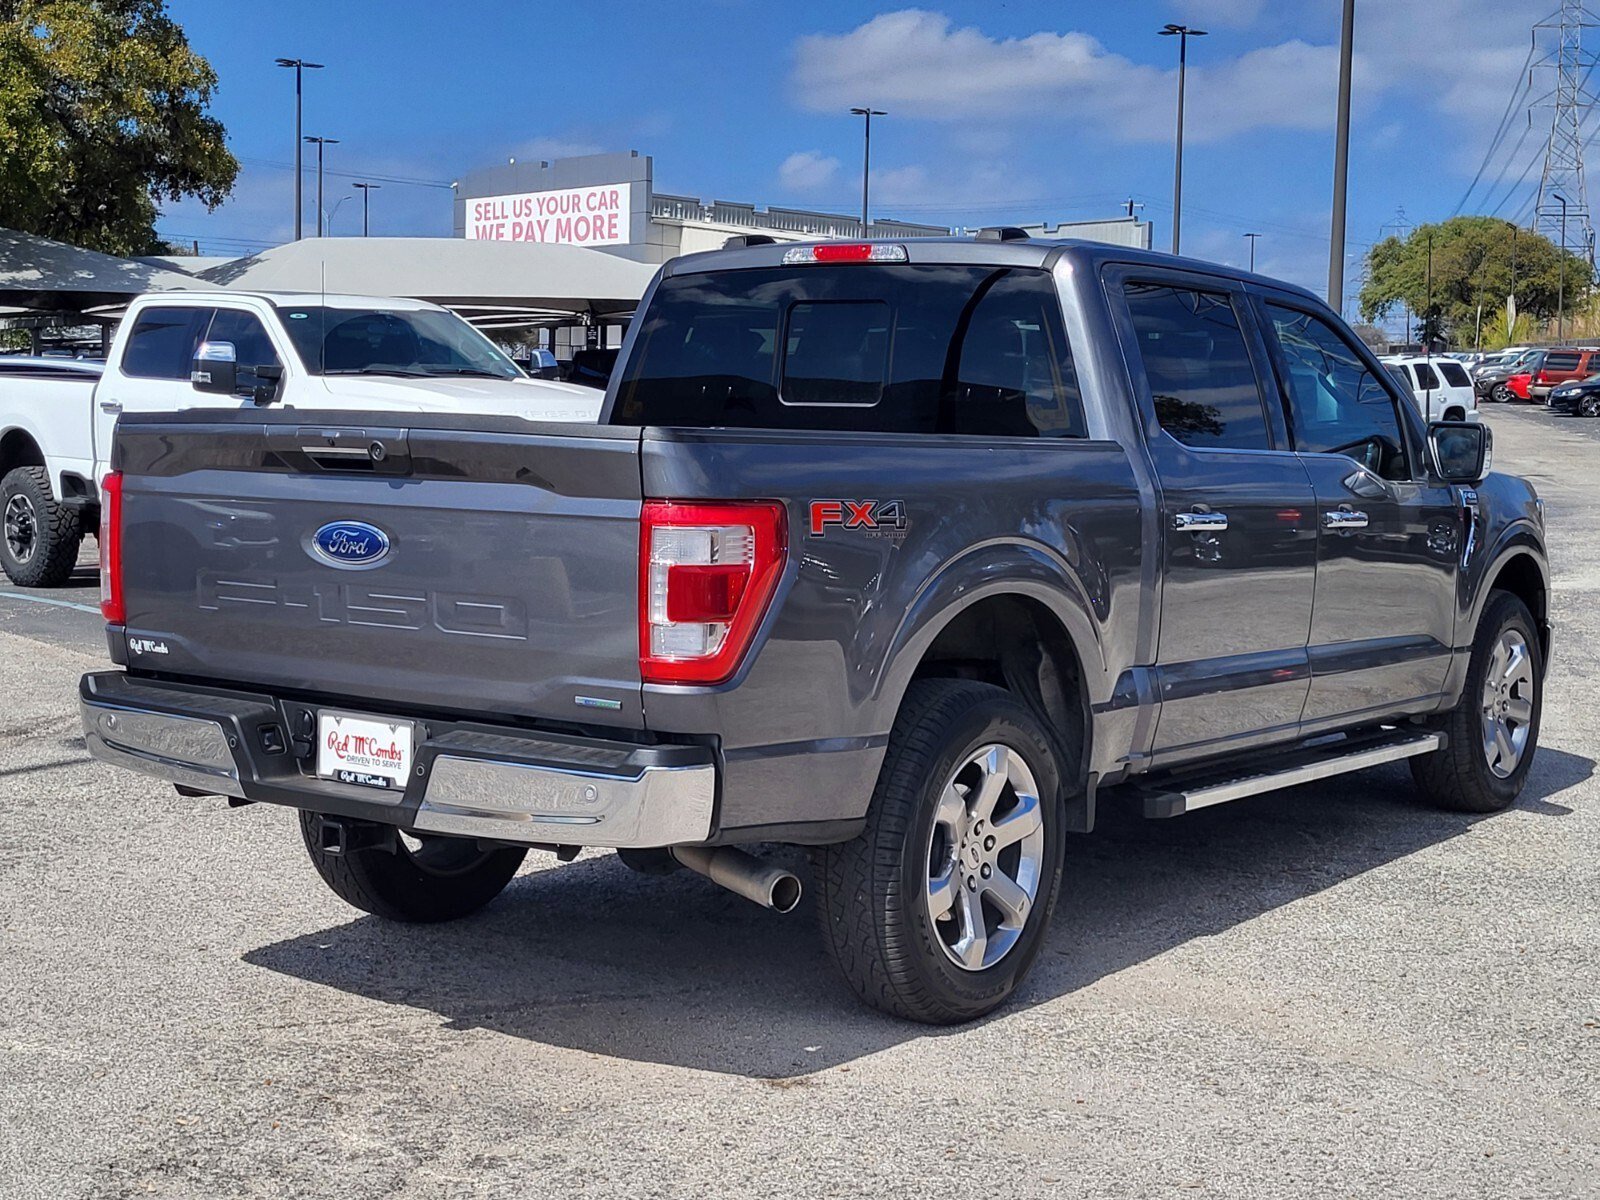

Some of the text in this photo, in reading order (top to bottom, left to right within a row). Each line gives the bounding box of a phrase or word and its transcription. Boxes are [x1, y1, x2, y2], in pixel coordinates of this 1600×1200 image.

[475, 190, 619, 222] SELL US YOUR CAR
[512, 219, 549, 243] PAY
[555, 213, 618, 243] MORE
[809, 498, 907, 538] FX4
[328, 529, 369, 557] Ford
[327, 731, 402, 761] Red McCombs
[346, 754, 402, 770] DRIVEN TO SERVE
